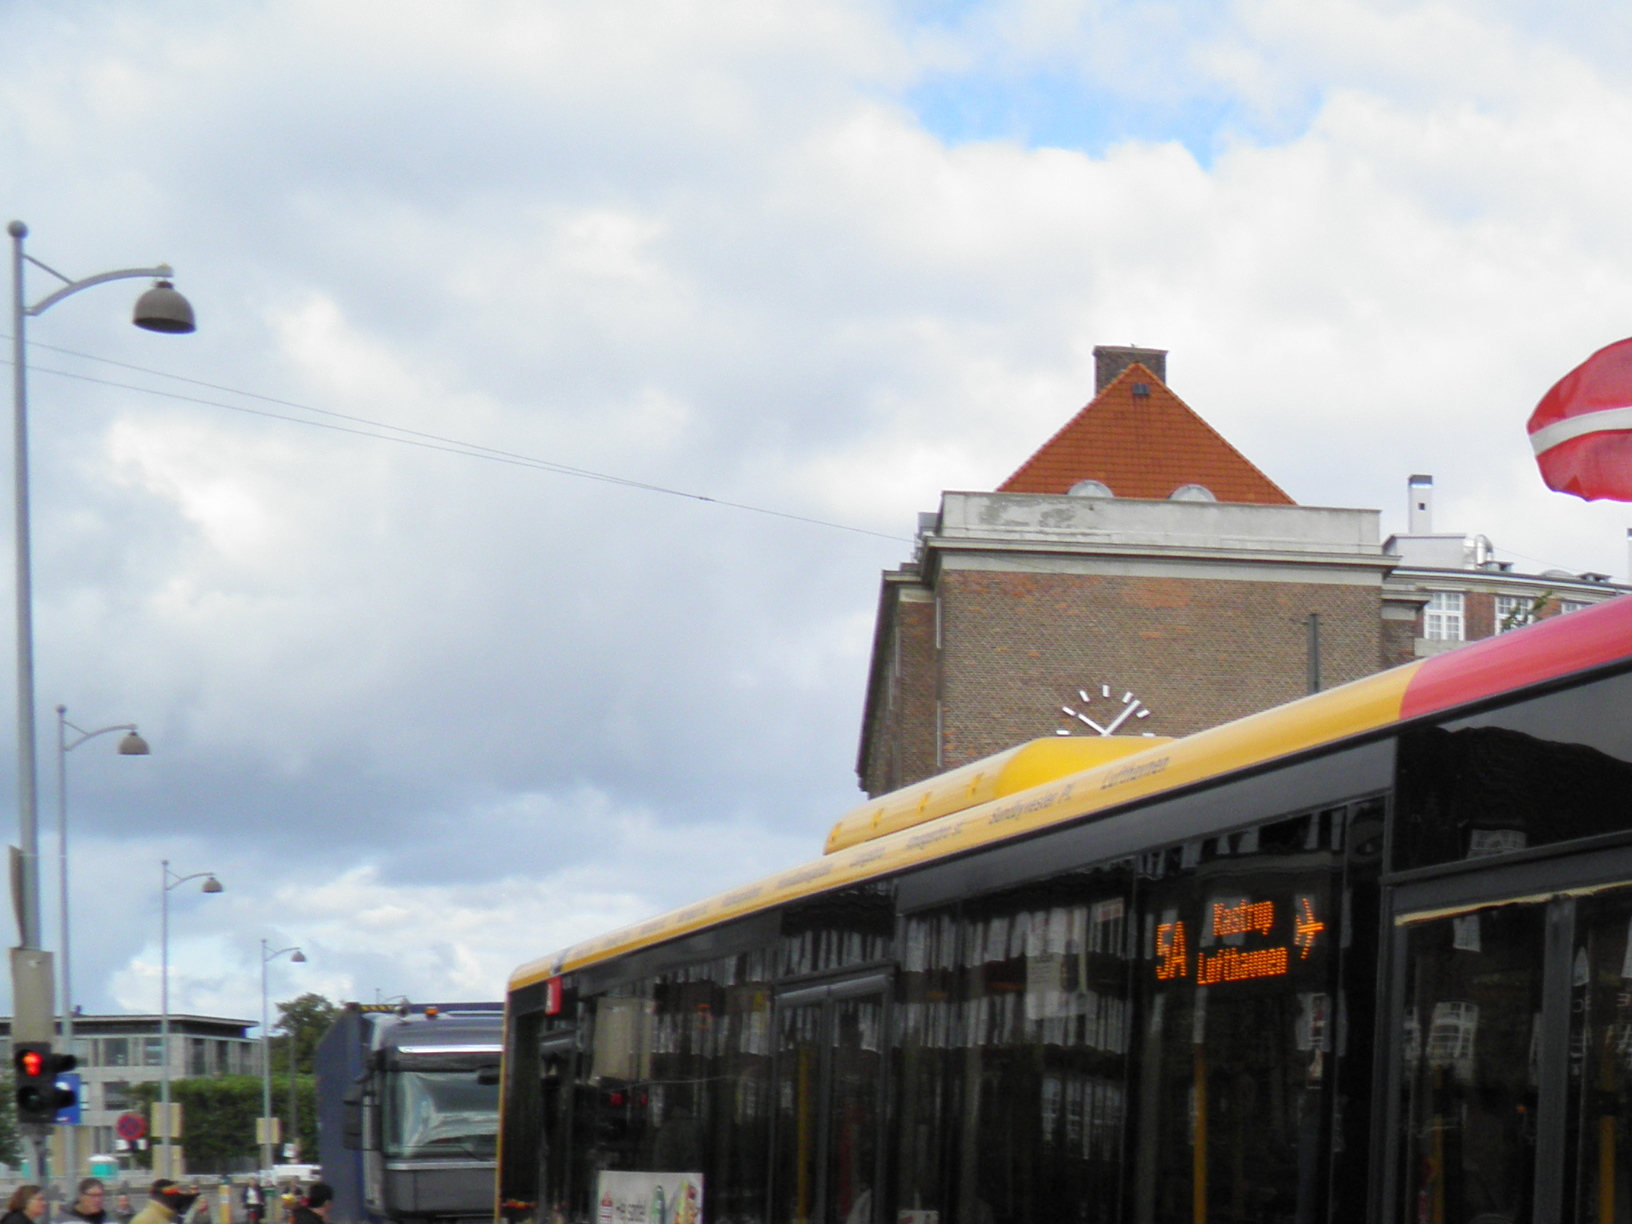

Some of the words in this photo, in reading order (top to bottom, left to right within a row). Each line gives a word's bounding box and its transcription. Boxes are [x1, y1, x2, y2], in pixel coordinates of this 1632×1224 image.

[1213, 899, 1274, 936] Kastrup
[1156, 921, 1187, 979] 5A
[1197, 947, 1288, 985] Lufthavnen
